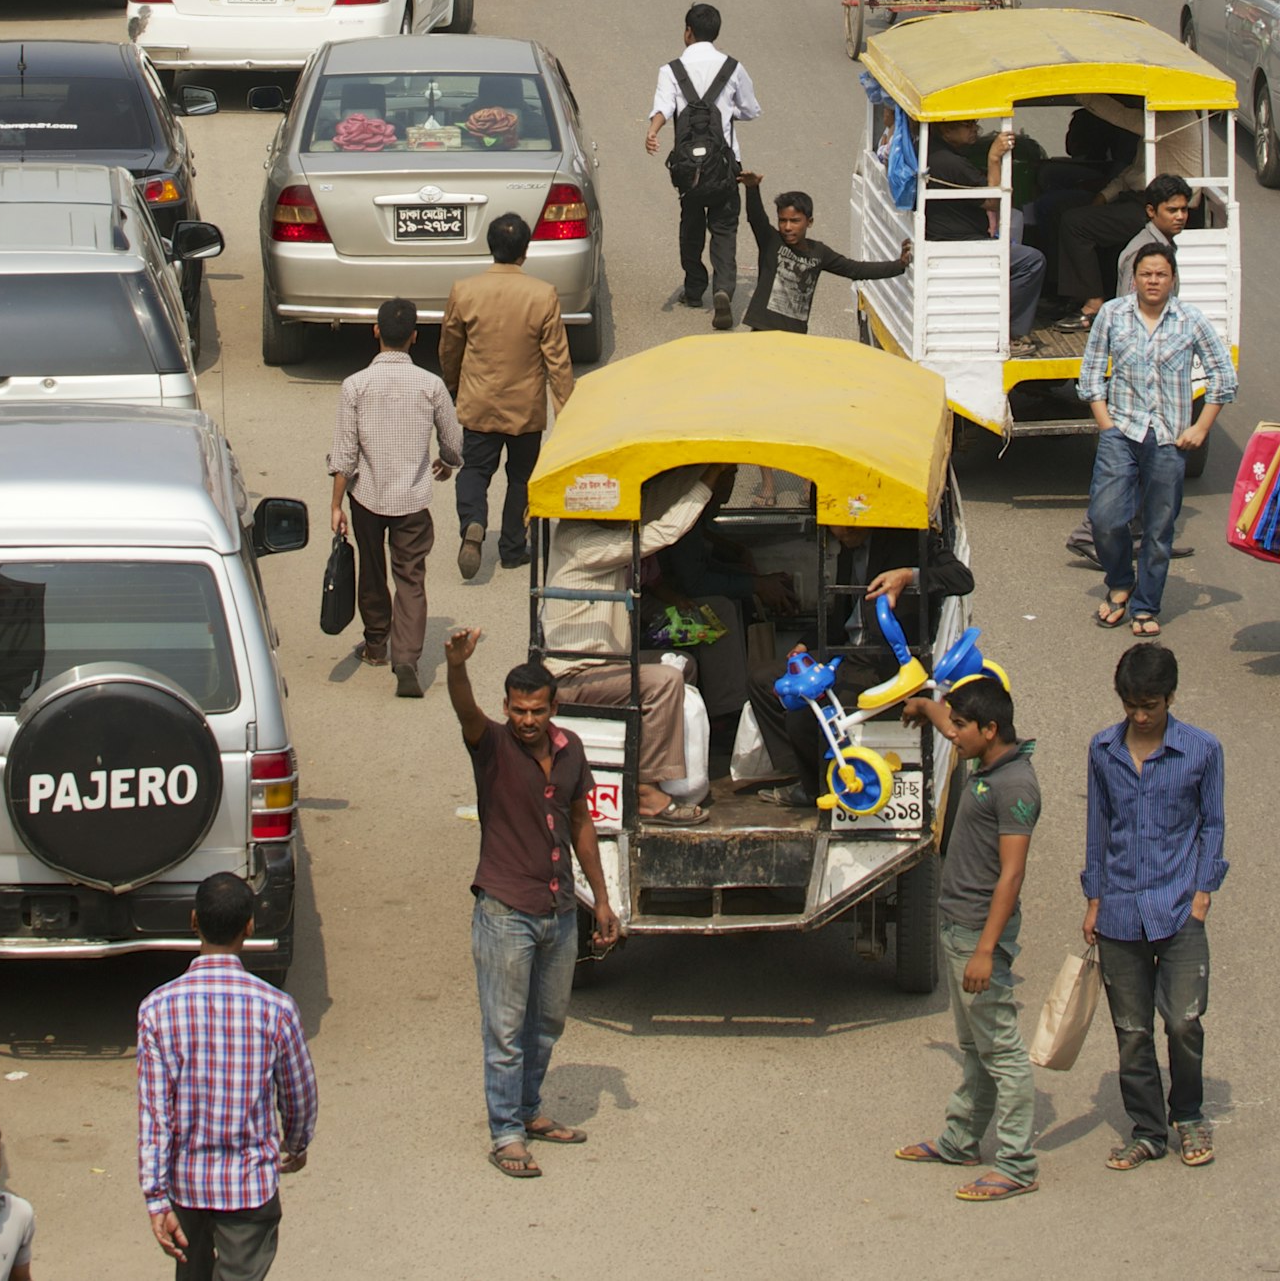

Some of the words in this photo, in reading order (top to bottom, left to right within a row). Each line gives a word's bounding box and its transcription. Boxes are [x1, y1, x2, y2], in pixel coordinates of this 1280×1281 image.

[399, 209, 421, 220] ঢাকা
[398, 221, 461, 233] ১৯-২৭৮৫
[29, 764, 198, 814] PAJERO
